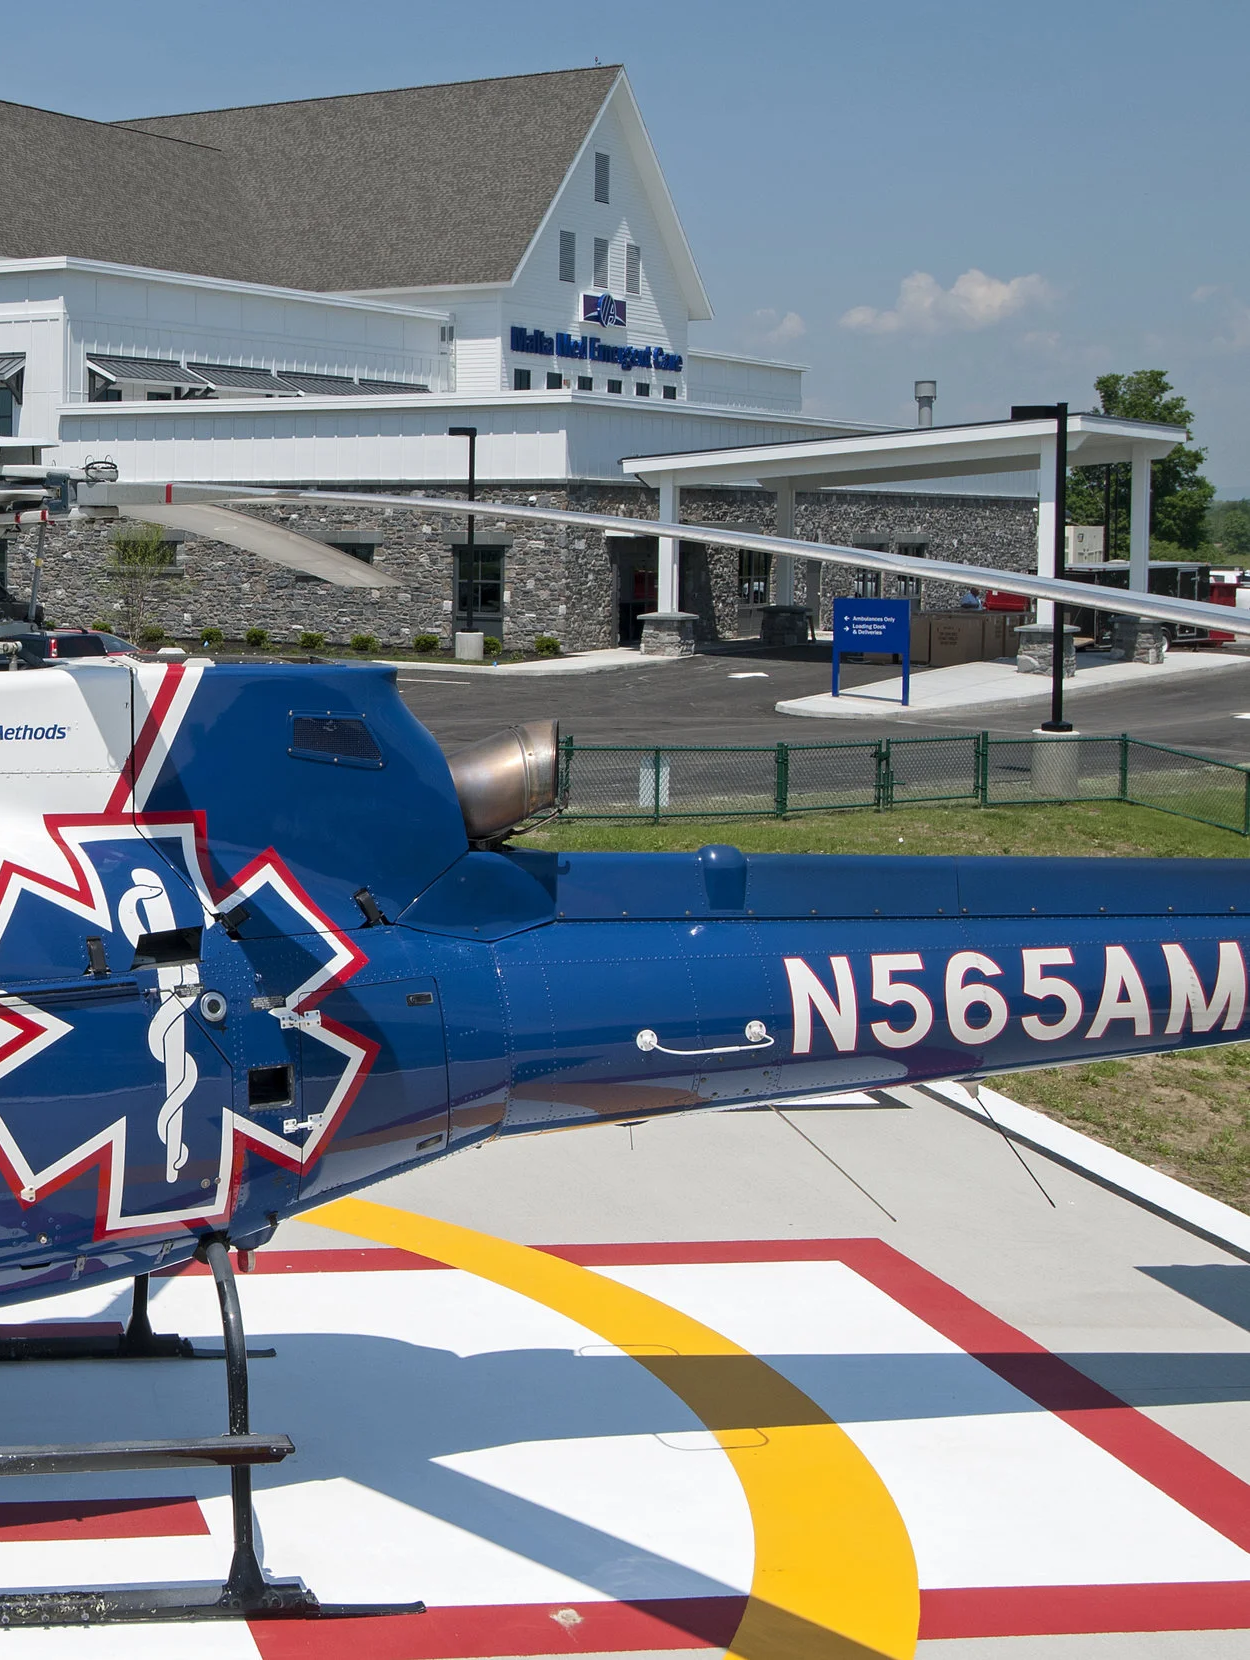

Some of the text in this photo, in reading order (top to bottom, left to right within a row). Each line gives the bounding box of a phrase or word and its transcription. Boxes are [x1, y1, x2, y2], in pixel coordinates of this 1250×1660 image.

[511, 326, 683, 372] Malta Med Emergent Care
[783, 941, 1247, 1055] N565AM
